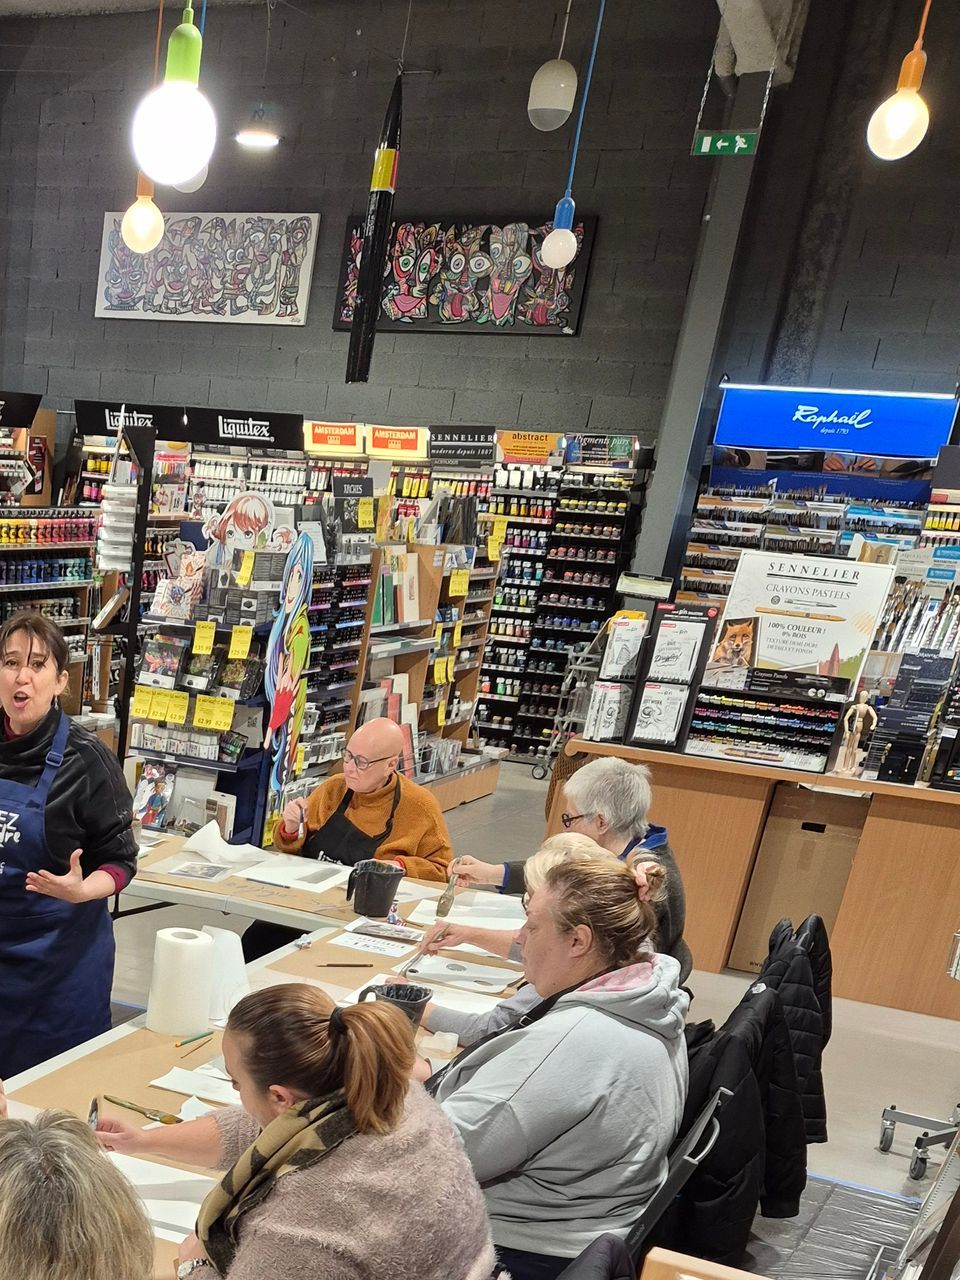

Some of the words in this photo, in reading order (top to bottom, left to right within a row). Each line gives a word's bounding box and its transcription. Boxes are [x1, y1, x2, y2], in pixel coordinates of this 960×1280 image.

[792, 404, 874, 429] Raphaël
[218, 415, 272, 440] Liquitex
[314, 426, 354, 435] AMSTERDAM
[374, 431, 416, 440] AMSTERDAM
[431, 434, 493, 442] SENNELIER
[512, 432, 548, 442] abstract
[574, 434, 609, 447] Pigments
[610, 437, 629, 448] purs
[768, 561, 860, 580] SENNELIER
[765, 583, 810, 596] CRAYONS
[811, 587, 852, 600] PASTELS
